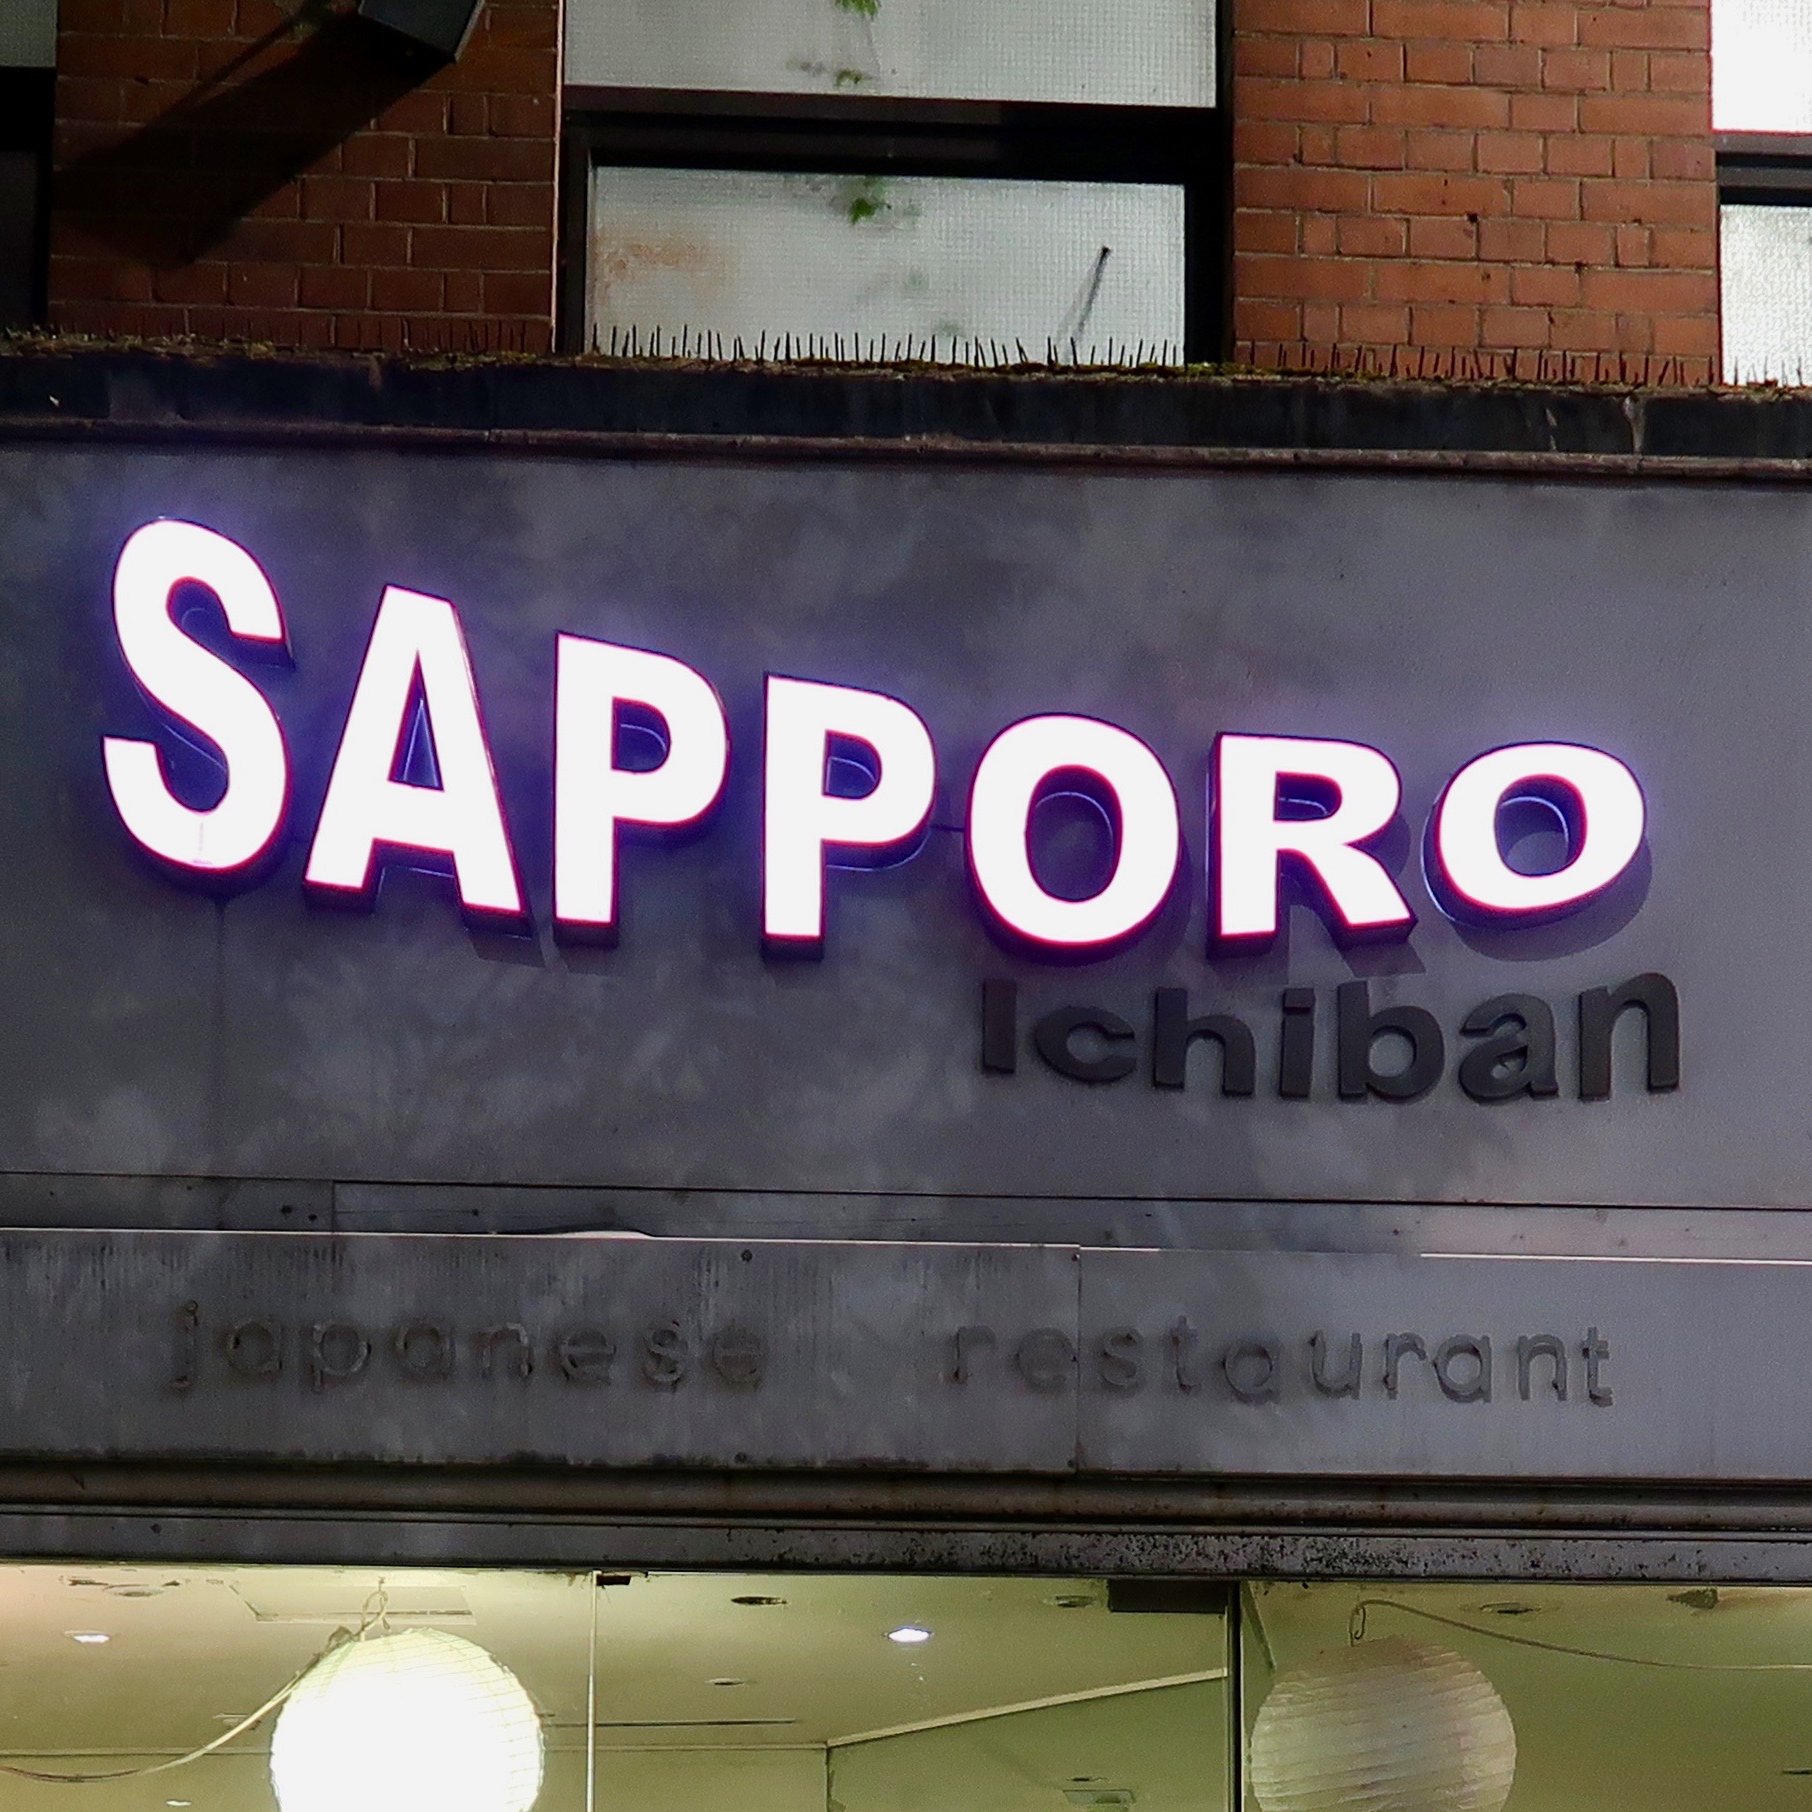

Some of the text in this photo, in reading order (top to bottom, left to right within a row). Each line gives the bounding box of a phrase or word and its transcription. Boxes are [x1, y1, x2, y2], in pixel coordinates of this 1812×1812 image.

[100, 516, 1650, 955] SAPPORO
[979, 971, 1684, 1102] Ichiban
[170, 1300, 1616, 1406] japanese restaurant
